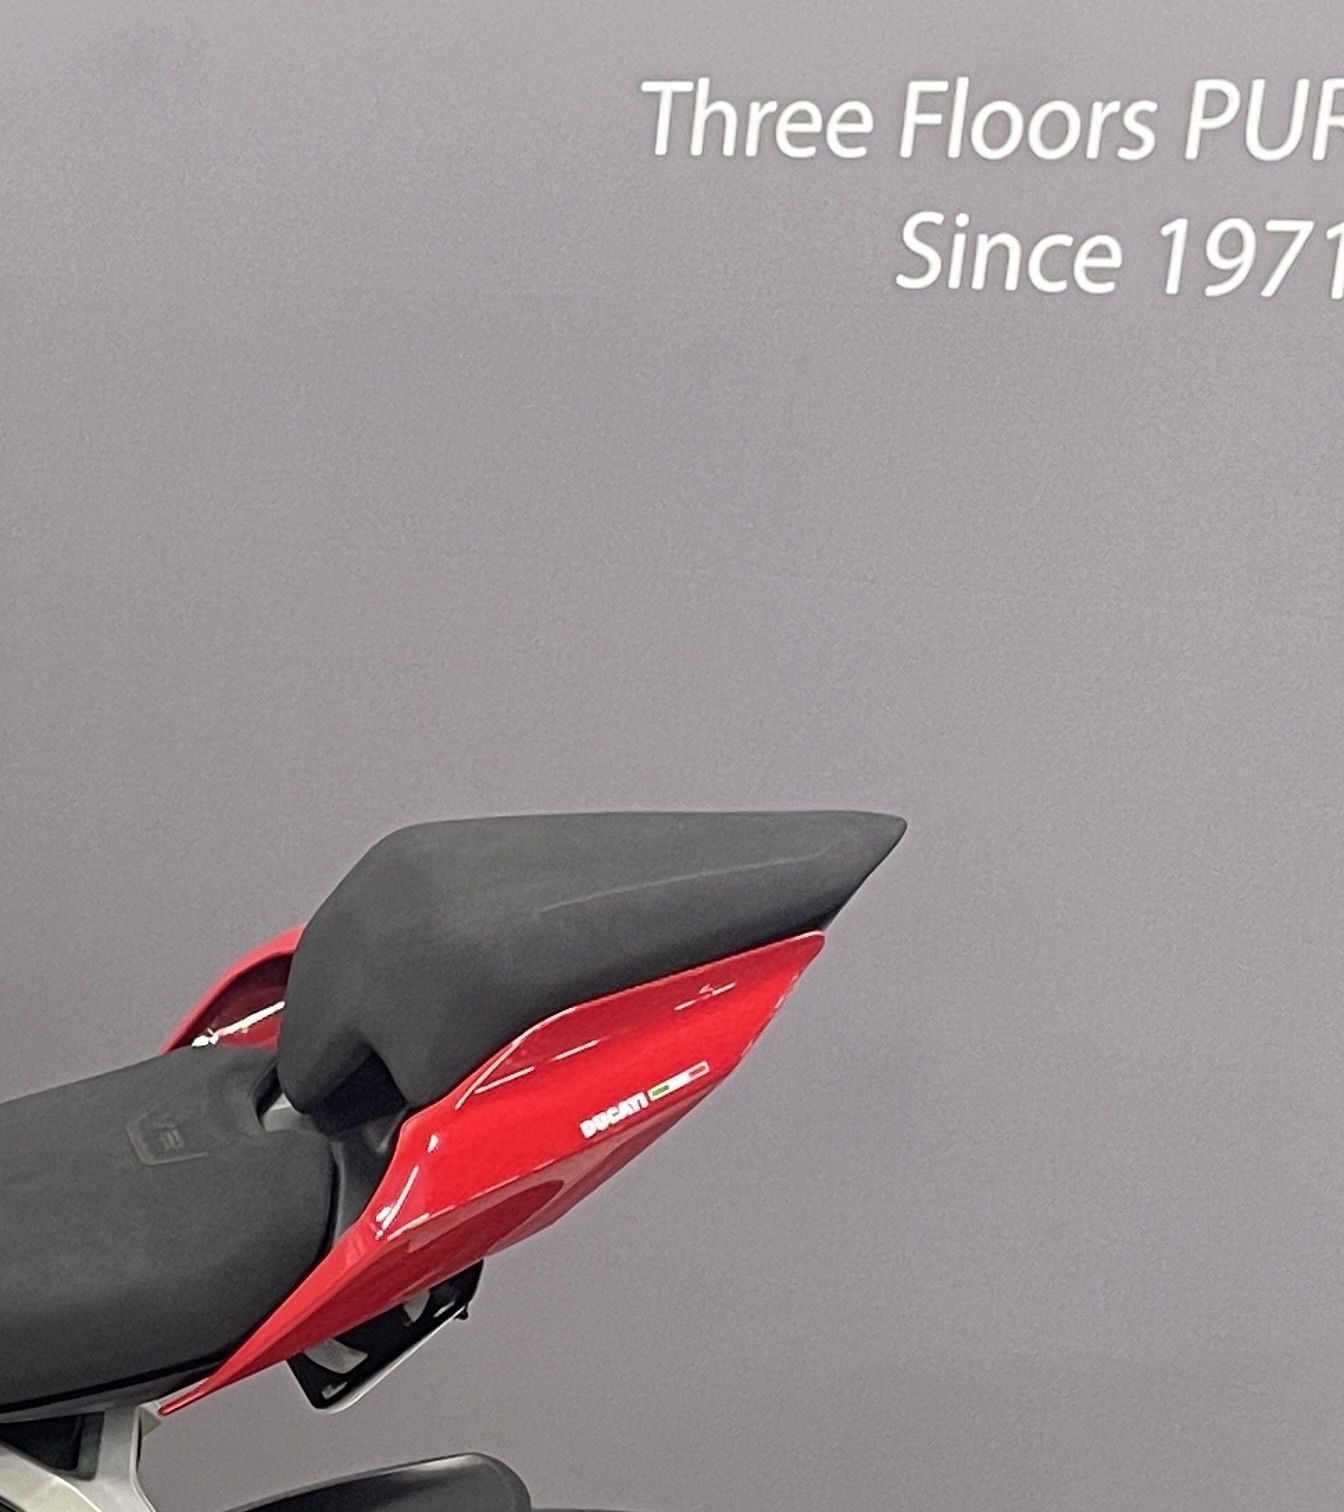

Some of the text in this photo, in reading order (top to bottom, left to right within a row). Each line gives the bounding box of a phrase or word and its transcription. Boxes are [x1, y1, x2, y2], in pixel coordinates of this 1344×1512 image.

[640, 77, 874, 158] Three
[900, 76, 1159, 160] Floors
[896, 211, 1344, 299] Since 1971
[579, 1091, 650, 1139] DUCATI
